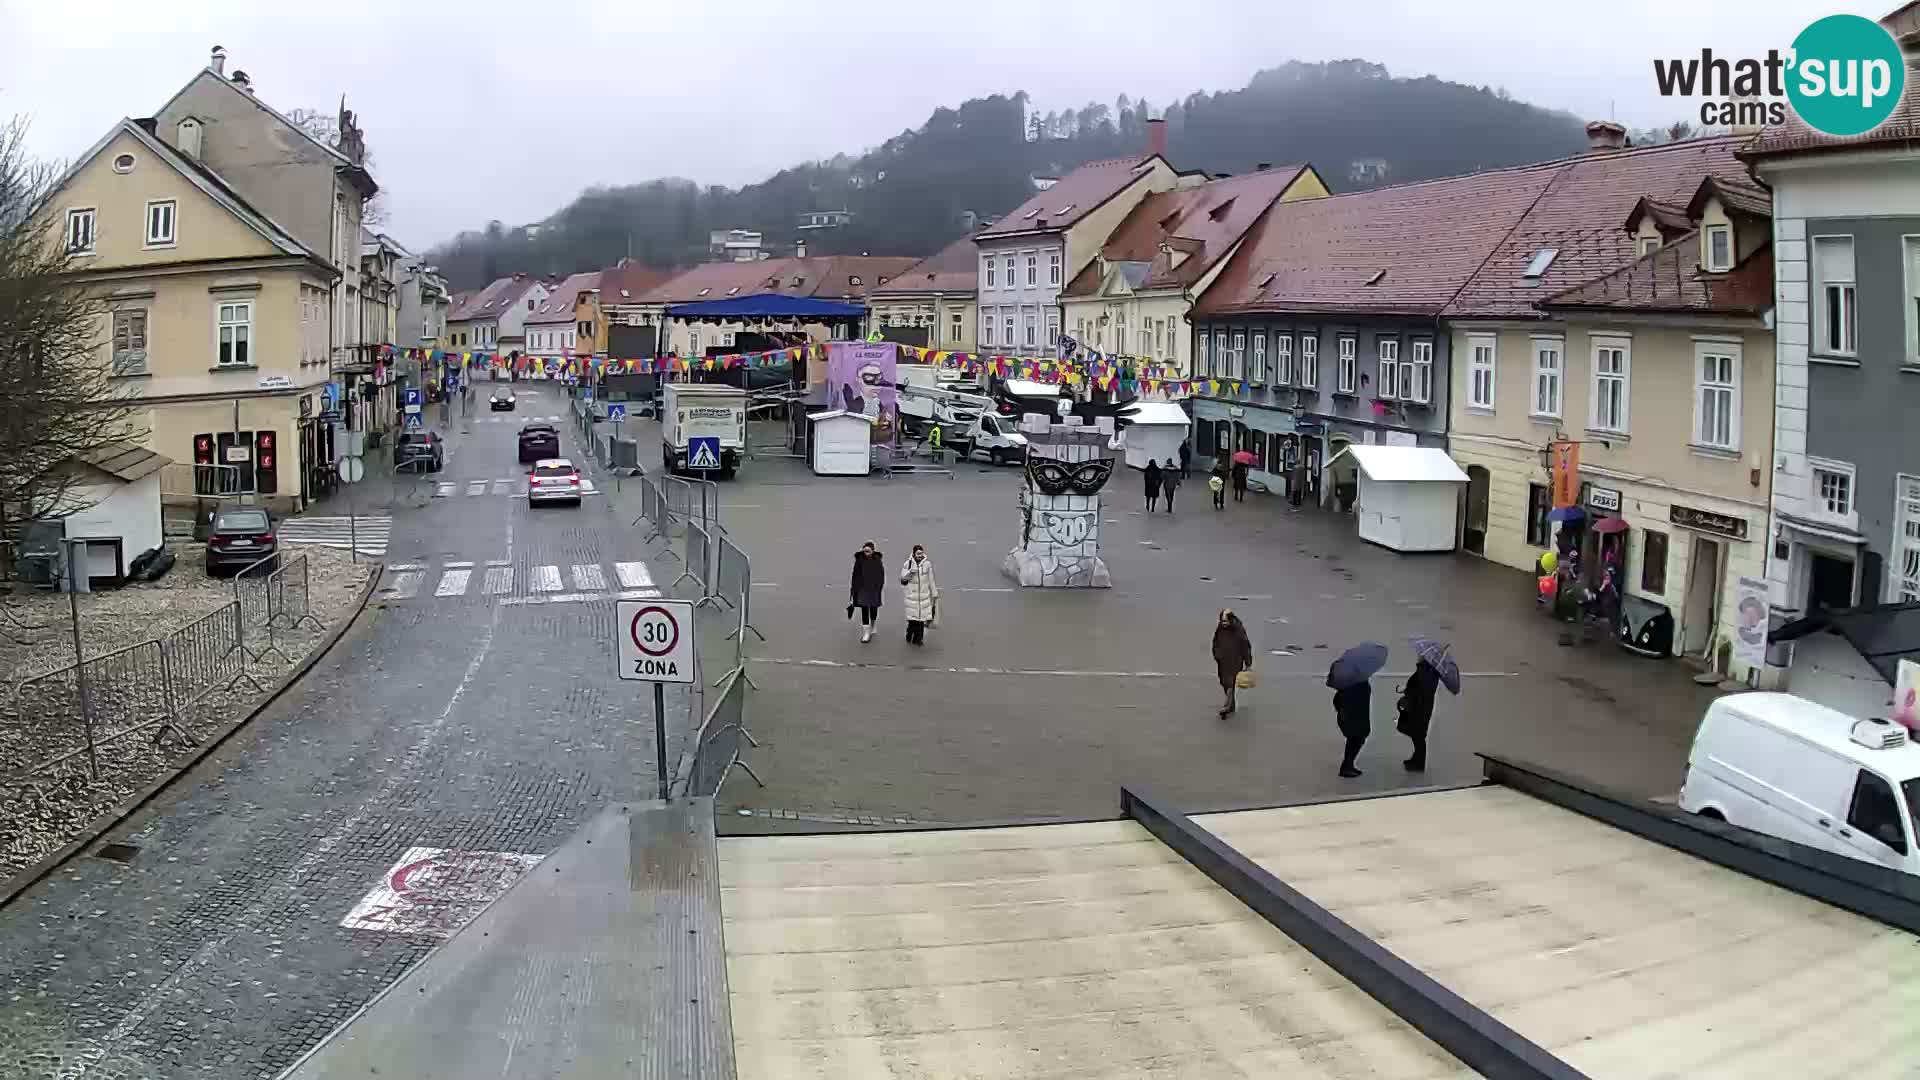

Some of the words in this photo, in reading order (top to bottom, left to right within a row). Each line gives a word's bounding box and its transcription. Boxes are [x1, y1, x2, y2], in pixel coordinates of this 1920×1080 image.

[408, 391, 417, 402] P
[1048, 514, 1086, 544] 200
[643, 622, 668, 643] 30
[634, 659, 678, 676] ZONA
